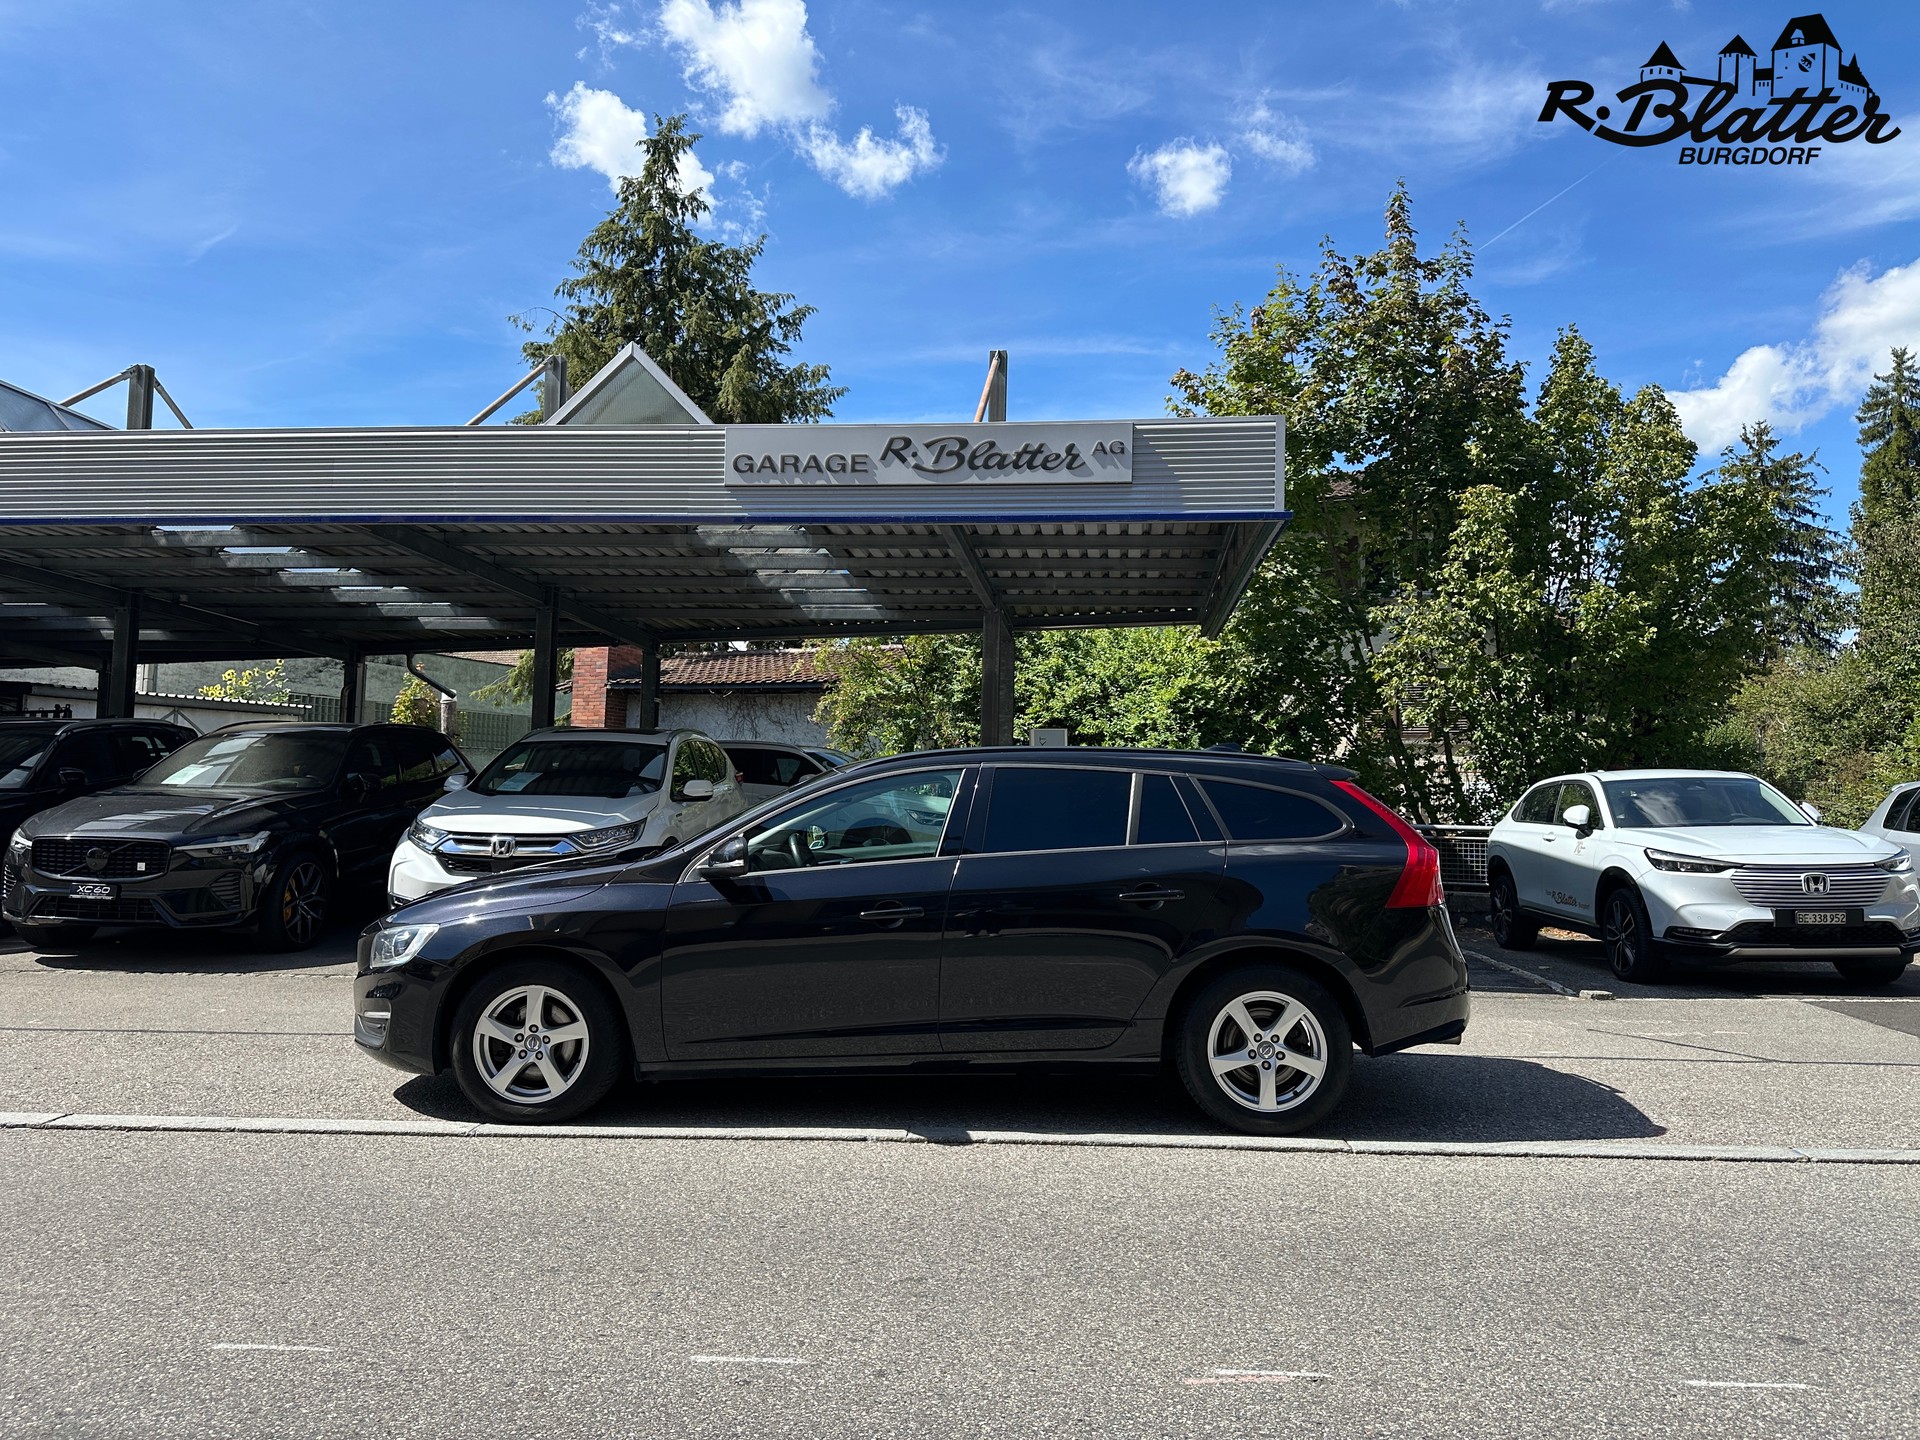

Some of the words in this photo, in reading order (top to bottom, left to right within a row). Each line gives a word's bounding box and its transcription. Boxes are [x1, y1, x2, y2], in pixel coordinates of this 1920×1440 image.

[732, 452, 870, 474] GARAGE
[1091, 440, 1125, 455] AG
[77, 885, 111, 894] XC60
